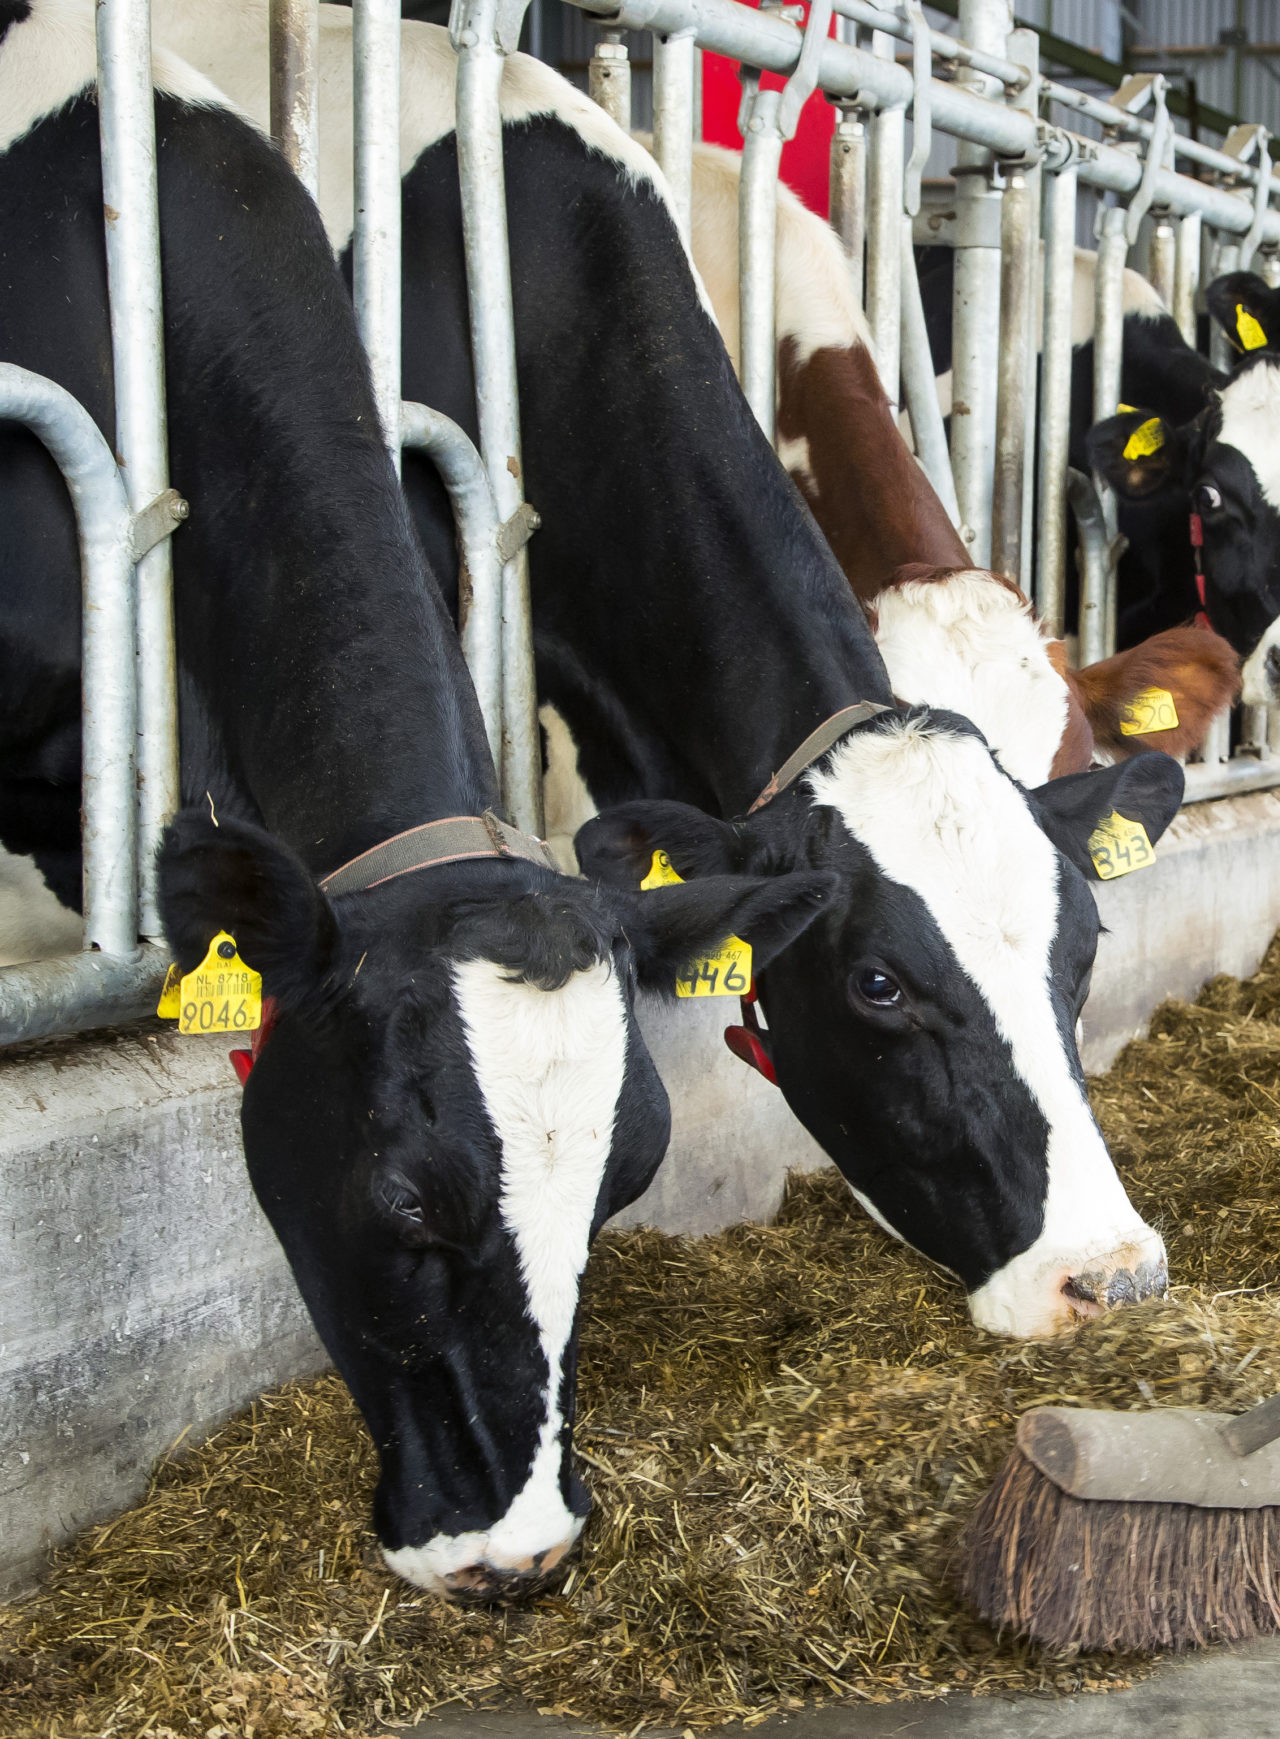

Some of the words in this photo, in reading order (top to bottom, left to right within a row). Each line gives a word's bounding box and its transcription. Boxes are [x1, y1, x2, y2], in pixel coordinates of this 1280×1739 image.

[1093, 835, 1149, 877] 343
[196, 975, 211, 985] NL
[217, 972, 249, 984] 8718
[680, 961, 746, 995] 446
[183, 998, 247, 1031] 9046
